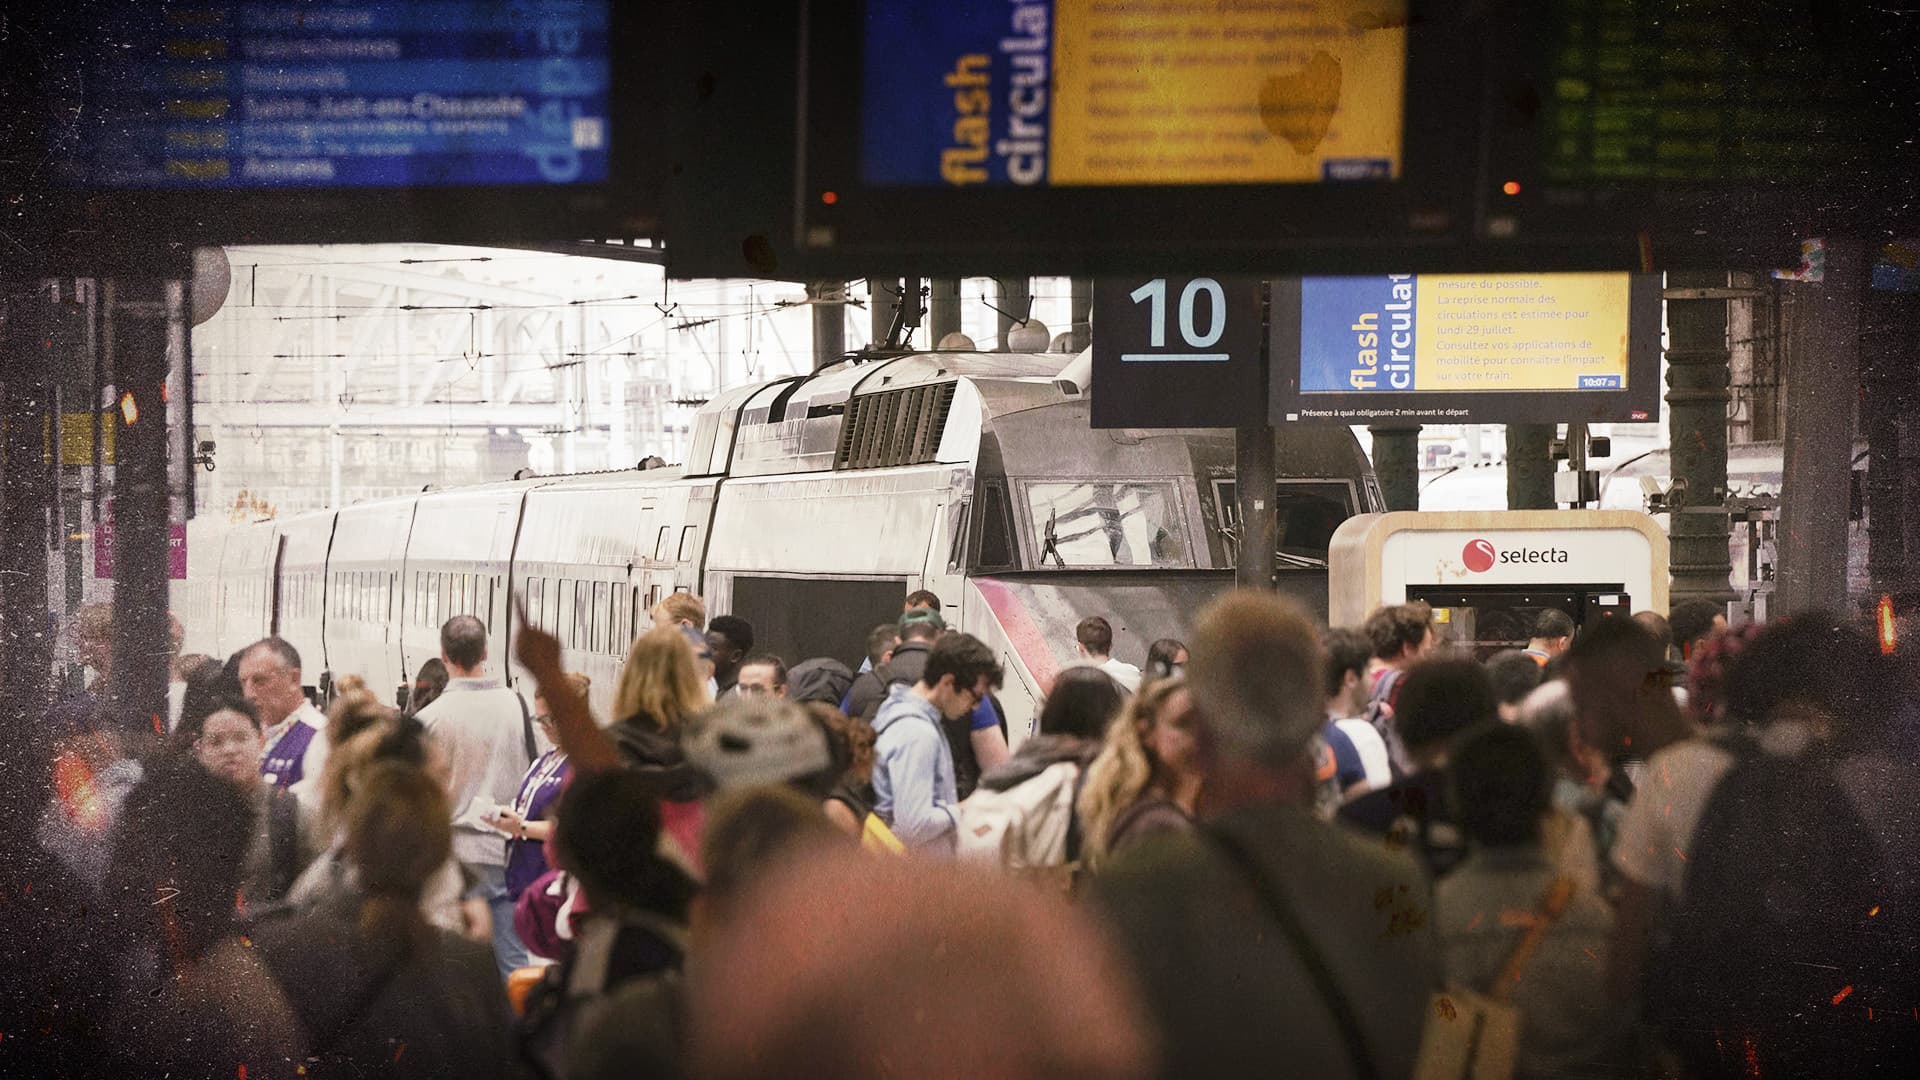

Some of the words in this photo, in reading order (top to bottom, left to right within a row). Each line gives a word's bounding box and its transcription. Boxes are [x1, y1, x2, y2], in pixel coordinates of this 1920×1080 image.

[996, 0, 1048, 184] circula
[941, 54, 989, 184] flash
[1438, 281, 1476, 289] mesure
[1480, 280, 1492, 288] du
[1496, 280, 1542, 292] possible.
[1438, 295, 1450, 304] La
[1453, 296, 1488, 307] reprise
[1492, 295, 1534, 304] normale
[1538, 295, 1556, 303] des
[1130, 278, 1226, 348] 10
[1437, 311, 1498, 320] circulations
[1521, 310, 1562, 319] estimée
[1565, 311, 1589, 322] pour
[1437, 326, 1463, 335] lundi
[1466, 326, 1479, 334] 29
[1482, 325, 1515, 337] juillet.
[1350, 313, 1378, 390] flash
[1436, 341, 1488, 350] Consultez
[1492, 342, 1509, 350] vos
[1512, 340, 1576, 351] applications
[1436, 356, 1480, 365] mobilité
[1484, 357, 1506, 367] pour
[1485, 371, 1512, 380] train.
[1583, 378, 1607, 387] 10:07
[1357, 409, 1393, 417] obligatoire
[1500, 547, 1568, 563] selecta
